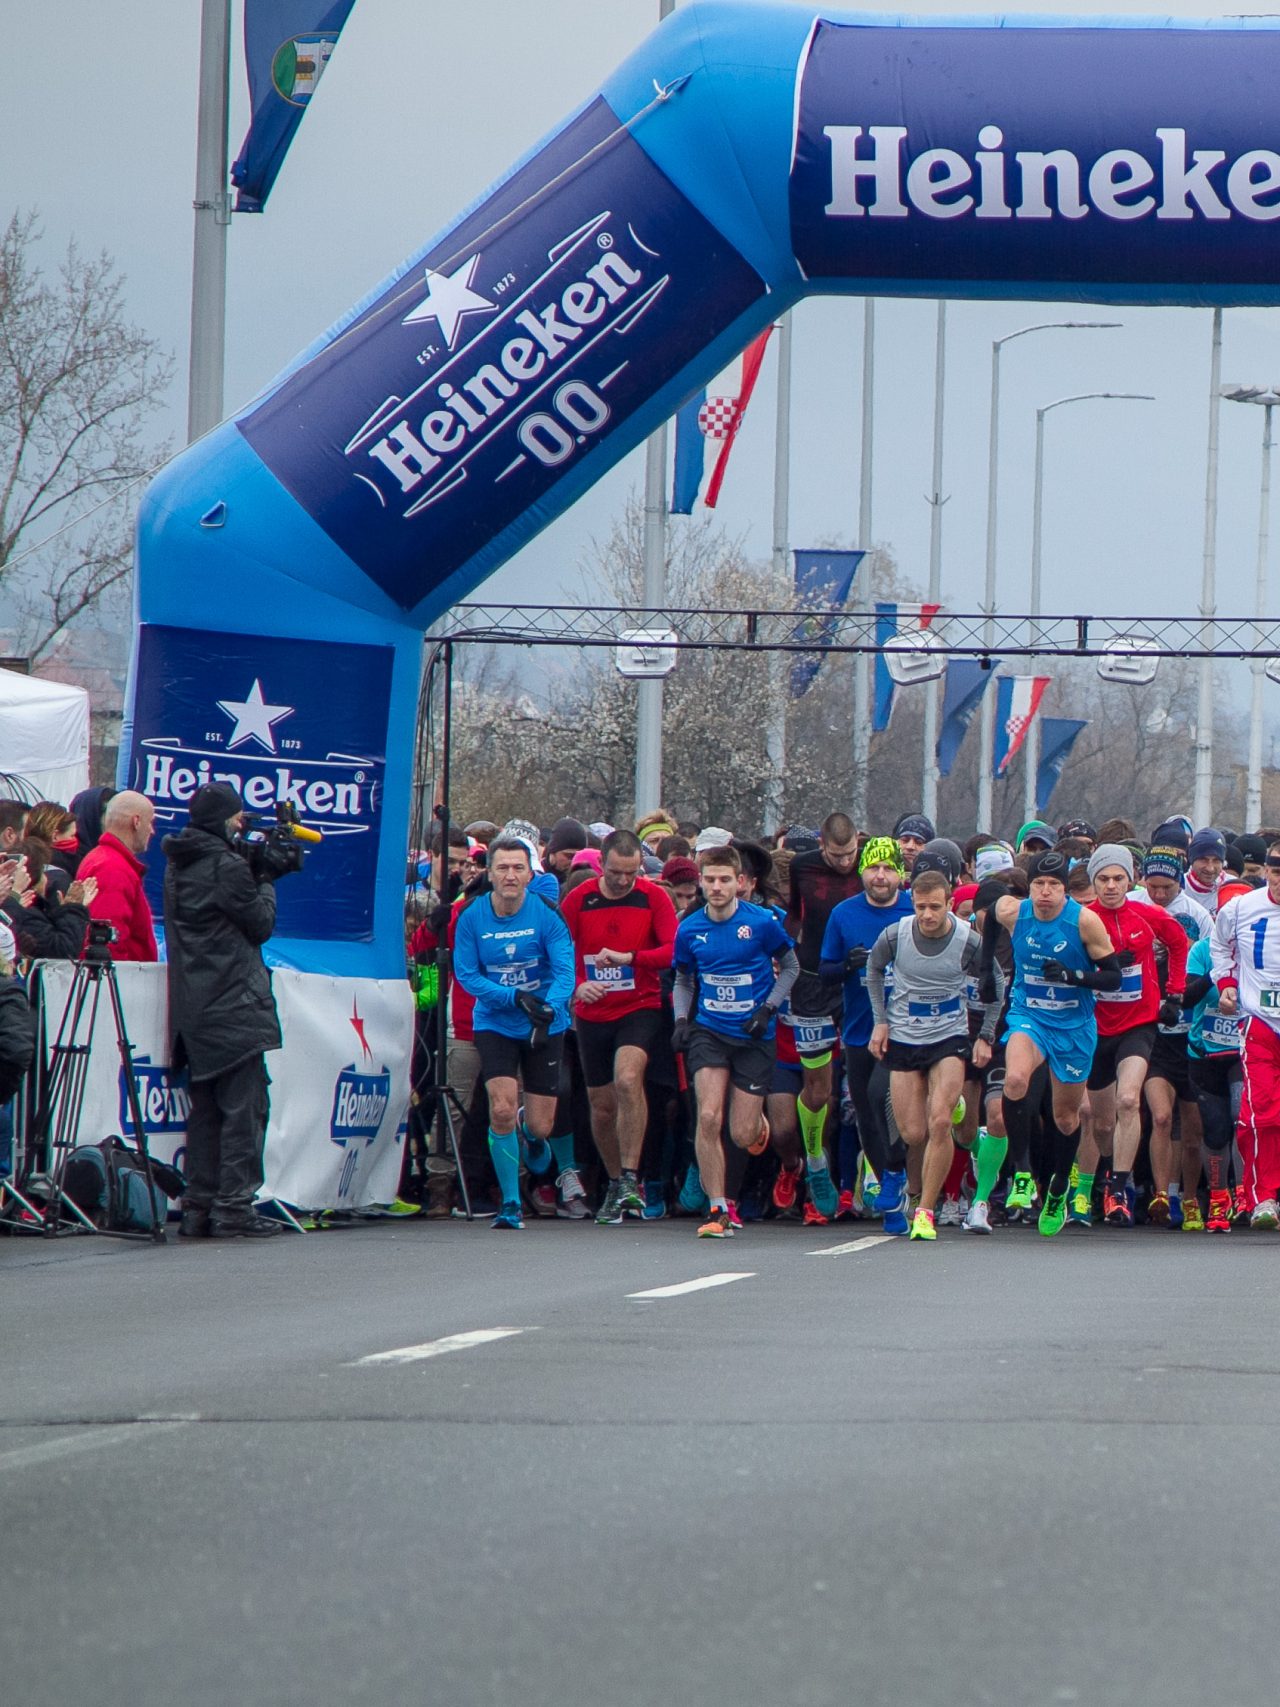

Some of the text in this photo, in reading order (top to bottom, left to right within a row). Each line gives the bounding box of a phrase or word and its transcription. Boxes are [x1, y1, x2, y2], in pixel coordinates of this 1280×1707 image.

[416, 273, 516, 366] EST. 1873
[368, 251, 642, 492] Heineken
[517, 379, 610, 466] 0.0
[205, 732, 302, 749] EST. 1873
[499, 969, 528, 987] 494
[594, 966, 622, 981] 686
[716, 986, 736, 1002] 99
[1046, 986, 1056, 1000] 4
[930, 1003, 940, 1016] 5
[800, 1027, 822, 1042] 107
[1214, 1018, 1240, 1036] 662
[126, 1074, 193, 1124] Hein
